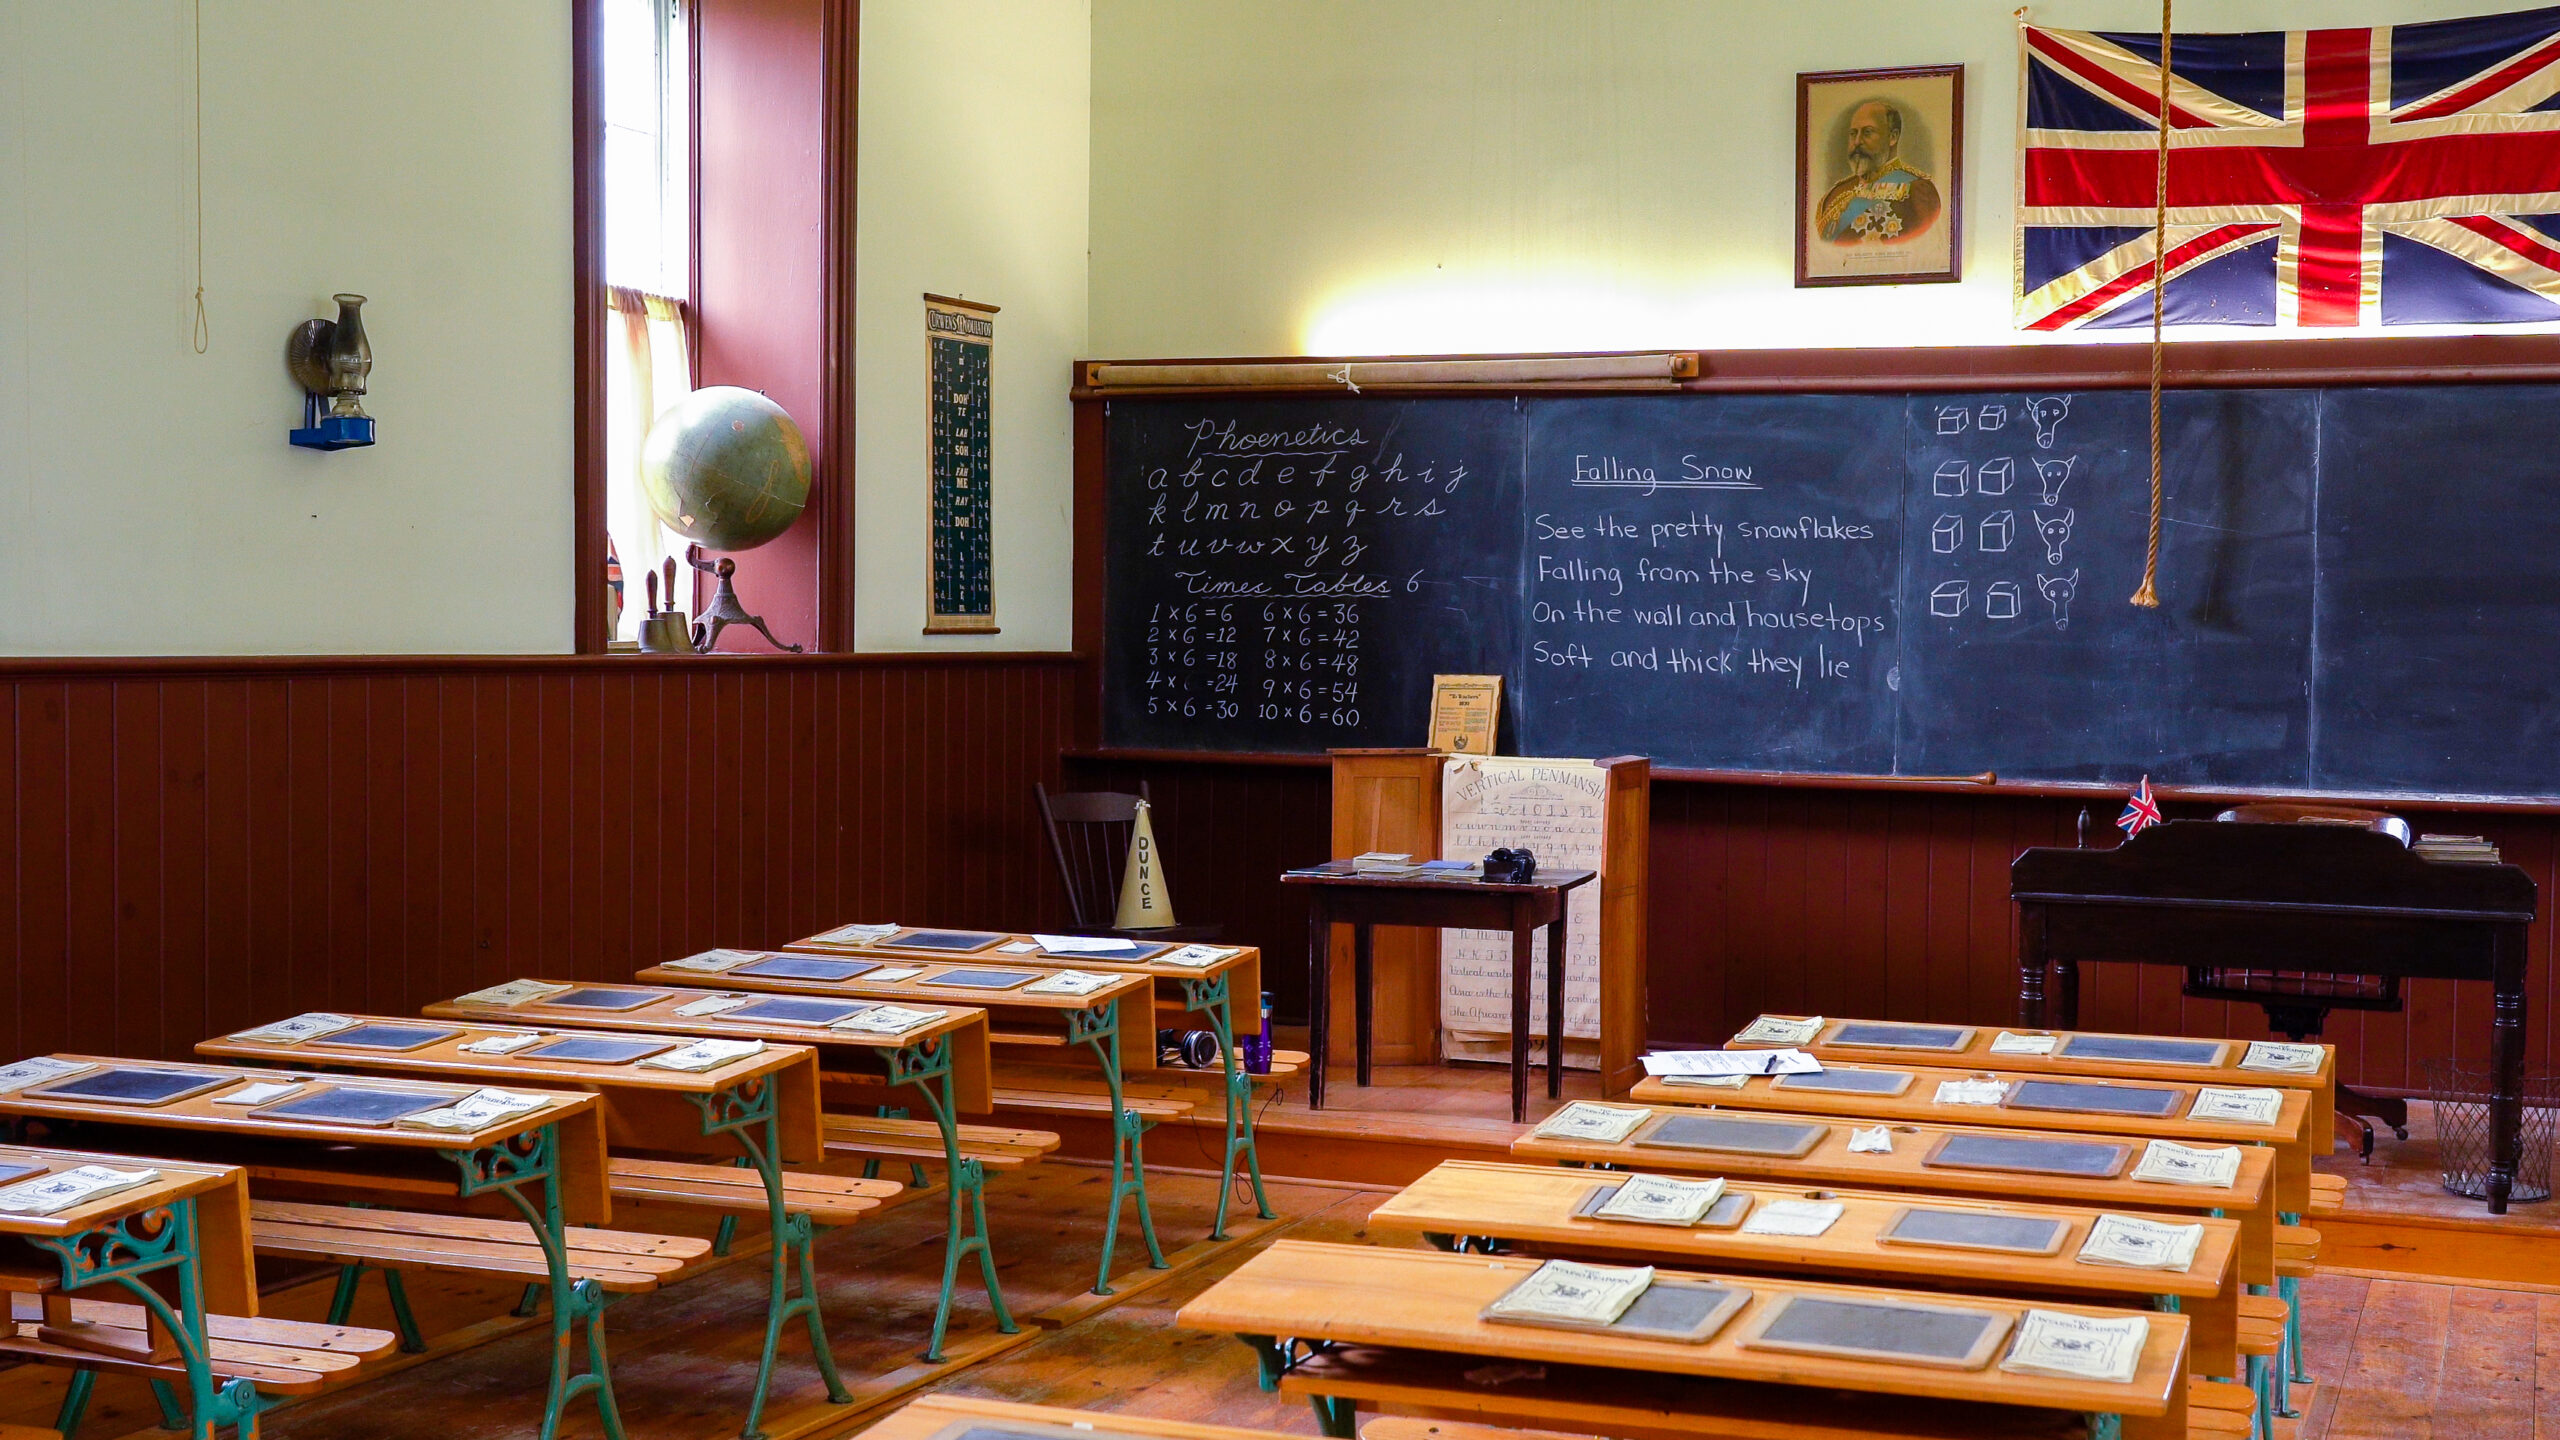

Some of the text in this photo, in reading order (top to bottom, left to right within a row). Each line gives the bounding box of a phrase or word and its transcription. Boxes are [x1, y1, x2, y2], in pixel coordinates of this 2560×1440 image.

[956, 428, 968, 438] LAH
[1184, 418, 1369, 458] Phoenetics
[955, 445, 969, 456] SOH
[956, 467, 968, 476] FAH
[956, 478, 968, 488] ME
[1148, 453, 1469, 493] a b c d e f g h i j
[1575, 455, 1752, 496] Falling Snow
[955, 496, 968, 505] RAY
[1148, 493, 1168, 525] k
[1181, 491, 1199, 523] l
[1205, 503, 1229, 520] m
[1239, 502, 1261, 519] n
[1273, 500, 1296, 518] o
[1306, 501, 1330, 524] p
[1376, 499, 1407, 516] r
[1413, 498, 1446, 517] s
[955, 517, 969, 527] DOH
[1535, 511, 1874, 558] See the pretty snowflakes
[1148, 533, 1368, 567] t u v w x y z
[1175, 569, 1424, 594] Times Tables 6
[1538, 556, 1812, 606] Falling from the sky
[1532, 600, 1885, 647] On the wall and housetops
[1533, 641, 1850, 689] Soft and thick they lie
[1456, 768, 1605, 802] VERTICAL PENMANSH
[1139, 837, 1152, 909] DUNCE
